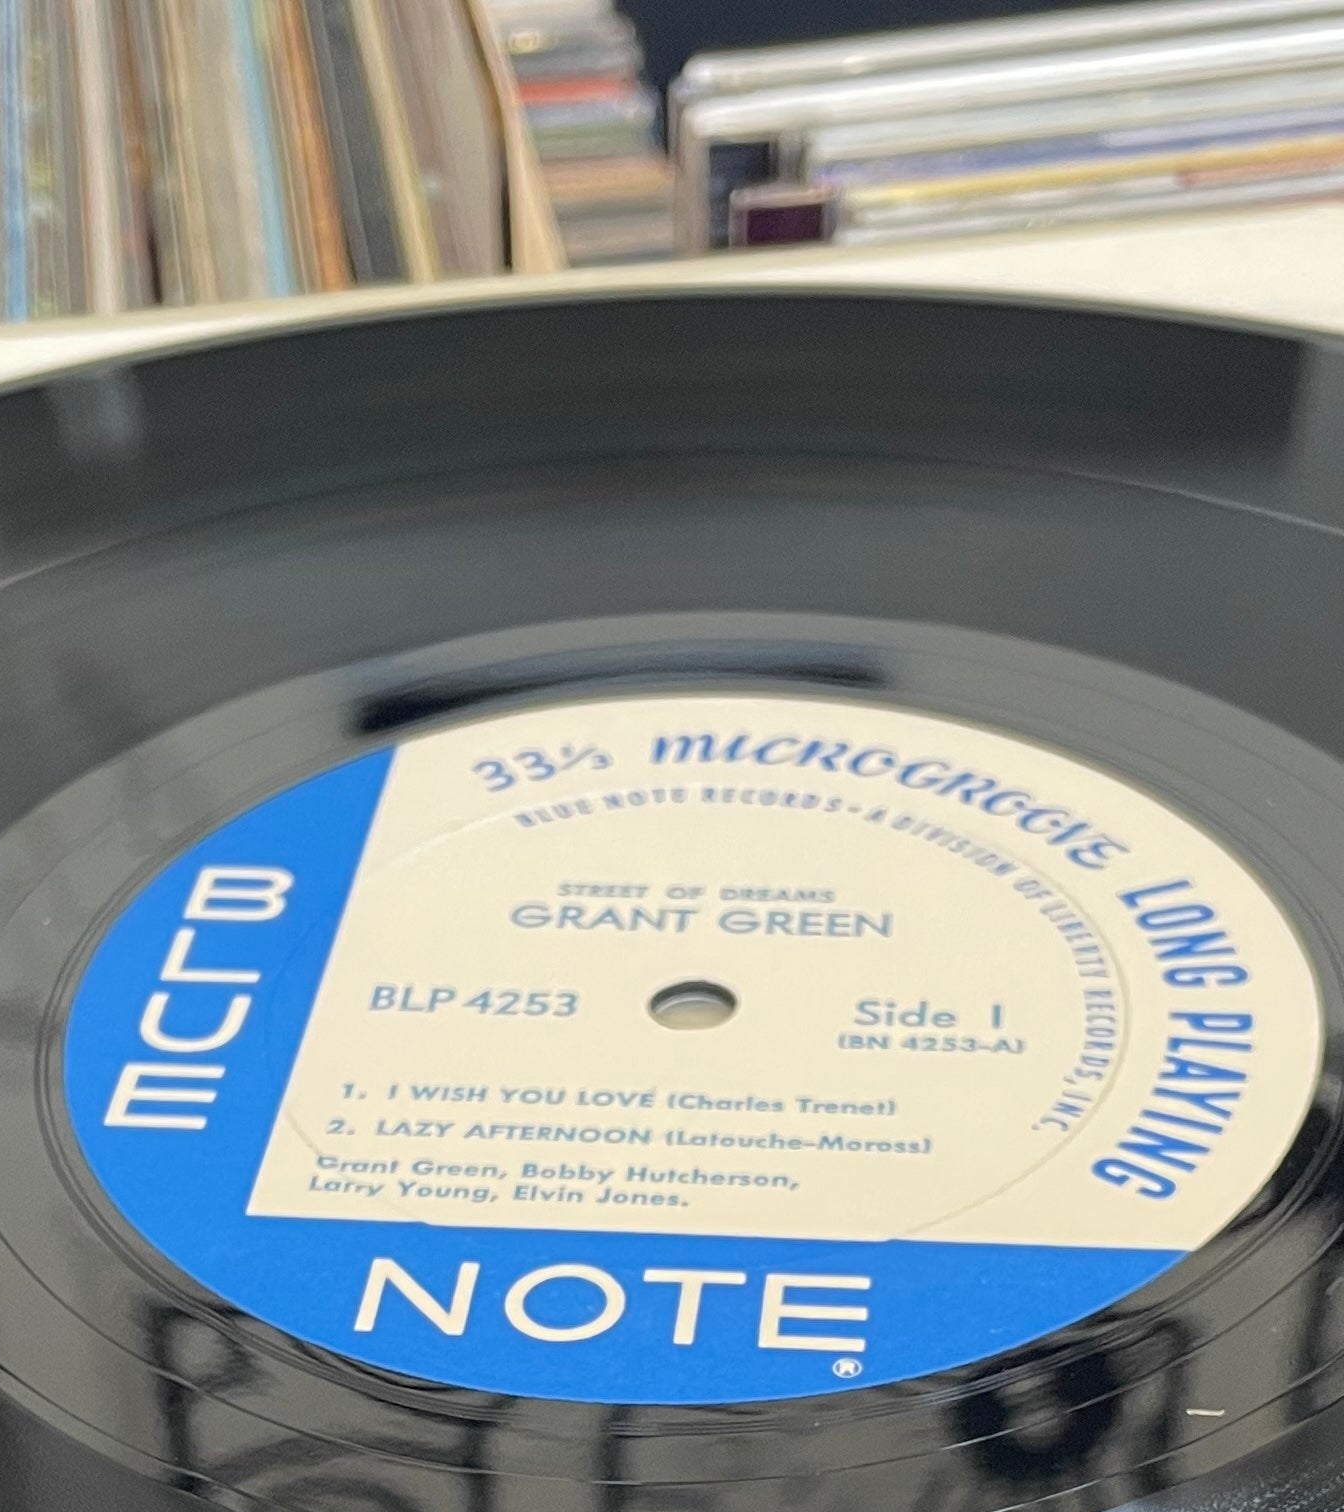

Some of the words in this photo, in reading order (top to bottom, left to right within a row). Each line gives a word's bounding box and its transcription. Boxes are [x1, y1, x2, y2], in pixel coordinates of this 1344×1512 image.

[514, 799, 594, 827] BLUE
[603, 787, 687, 810] NOTE
[891, 815, 1019, 876] DIVISION
[558, 883, 650, 899] STREET
[665, 886, 705, 900] OF
[719, 887, 836, 903] DREAMS
[1013, 879, 1053, 900] OF
[510, 903, 697, 934] GRANT
[718, 909, 893, 938] GREEN
[1116, 879, 1249, 989] LONG
[1039, 900, 1110, 979] LIBERTY
[103, 865, 294, 1129] BLUE
[370, 985, 456, 1013] BLP
[463, 988, 579, 1017] 4253
[854, 1000, 958, 1029] Side
[838, 1034, 890, 1053] (BN
[1063, 989, 1116, 1085] RECORDS,
[342, 1083, 367, 1100] 1.
[387, 1084, 398, 1100] I
[410, 1085, 488, 1102] WISH
[500, 1088, 566, 1105] YOU
[575, 1089, 655, 1108] LOVE
[667, 1092, 785, 1113] (Charles
[796, 1097, 897, 1116] Trenet)
[1032, 1090, 1092, 1132] INC.
[1091, 1011, 1253, 1200] PLAYING
[325, 1119, 355, 1136] 2.
[375, 1119, 455, 1138] LAZY
[463, 1123, 652, 1144] AFTERNOON
[316, 1155, 400, 1175] Grant
[411, 1160, 508, 1180] Green,
[521, 1163, 615, 1184] Bobby
[625, 1166, 800, 1191] Hutcherson,
[308, 1175, 384, 1197] Larry
[398, 1181, 499, 1203] Young,
[513, 1184, 584, 1204] Elvin
[595, 1188, 689, 1208] Jones.
[353, 1257, 871, 1352] NOTE
